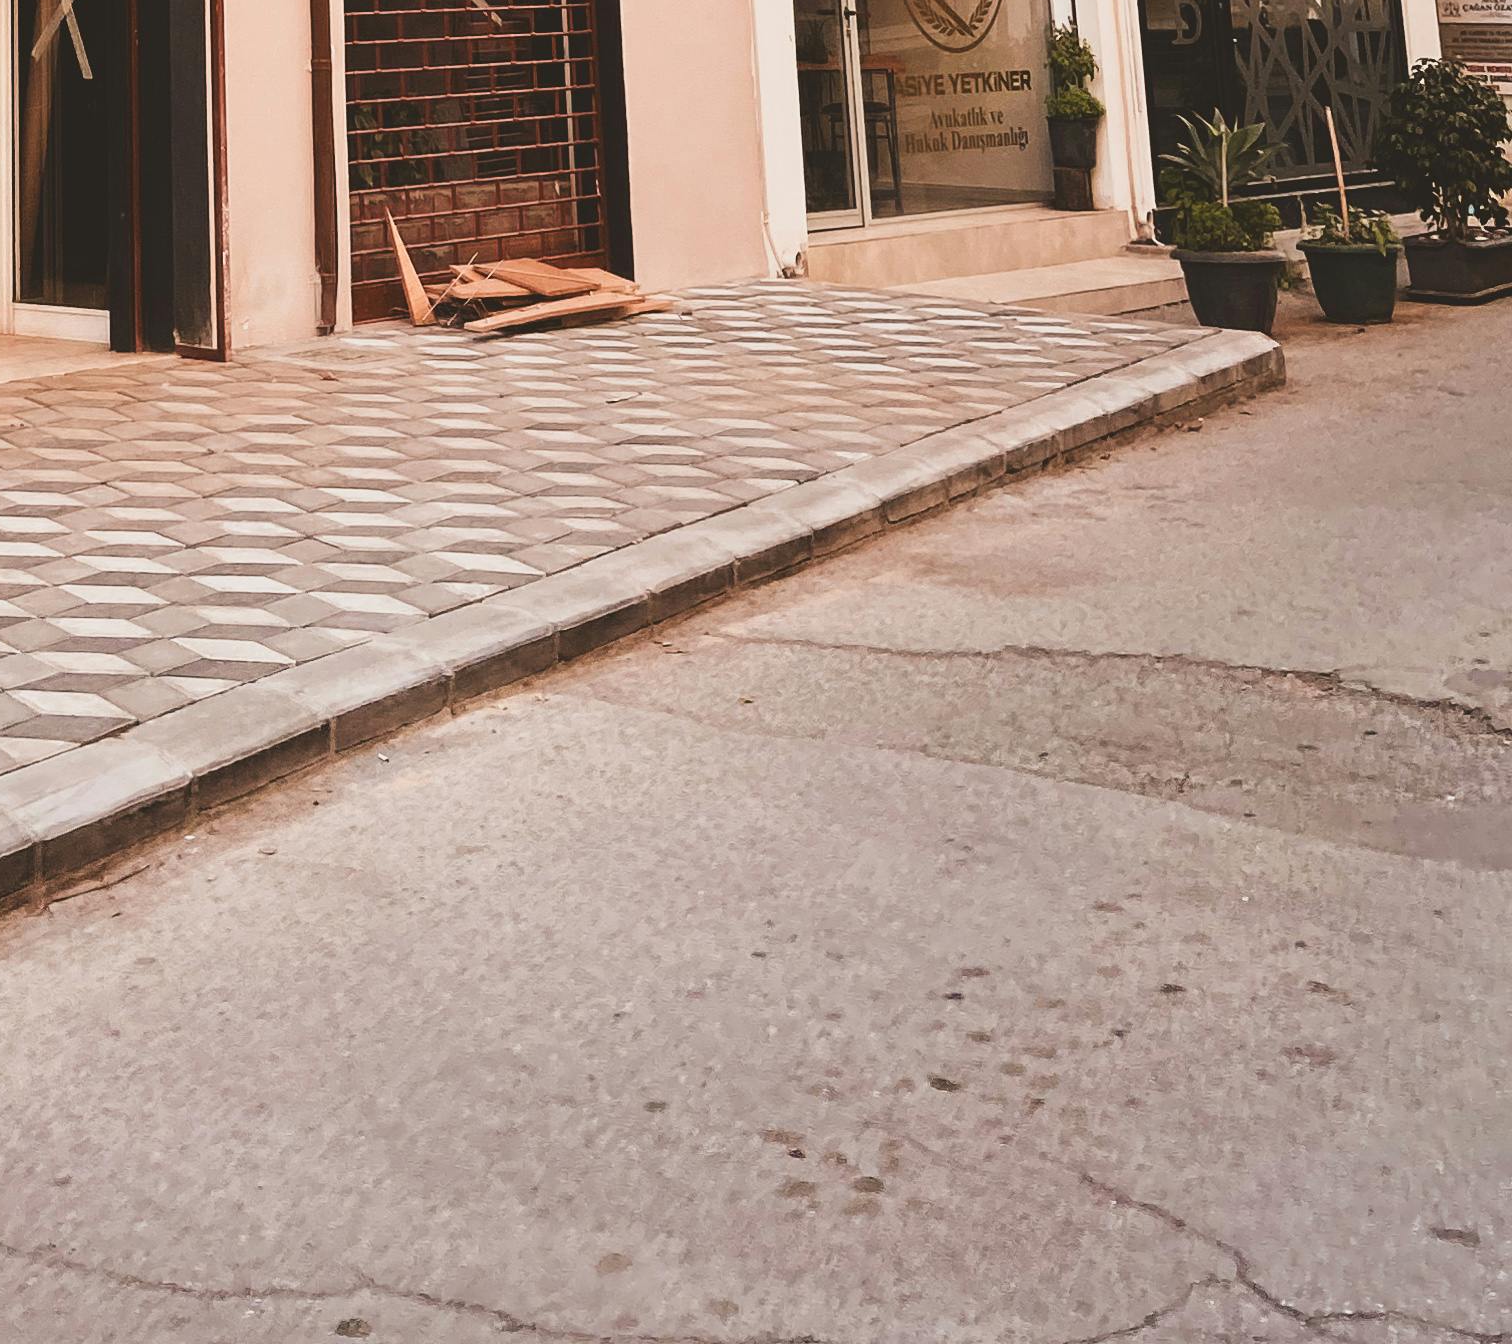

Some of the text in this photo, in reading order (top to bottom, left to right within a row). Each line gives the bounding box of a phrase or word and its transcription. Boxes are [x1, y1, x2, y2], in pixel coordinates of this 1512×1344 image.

[947, 70, 1032, 95] YETKİNER
[930, 107, 1004, 129] Avukatlık ve
[905, 126, 1029, 154] Hukuk Danışmanlığı
